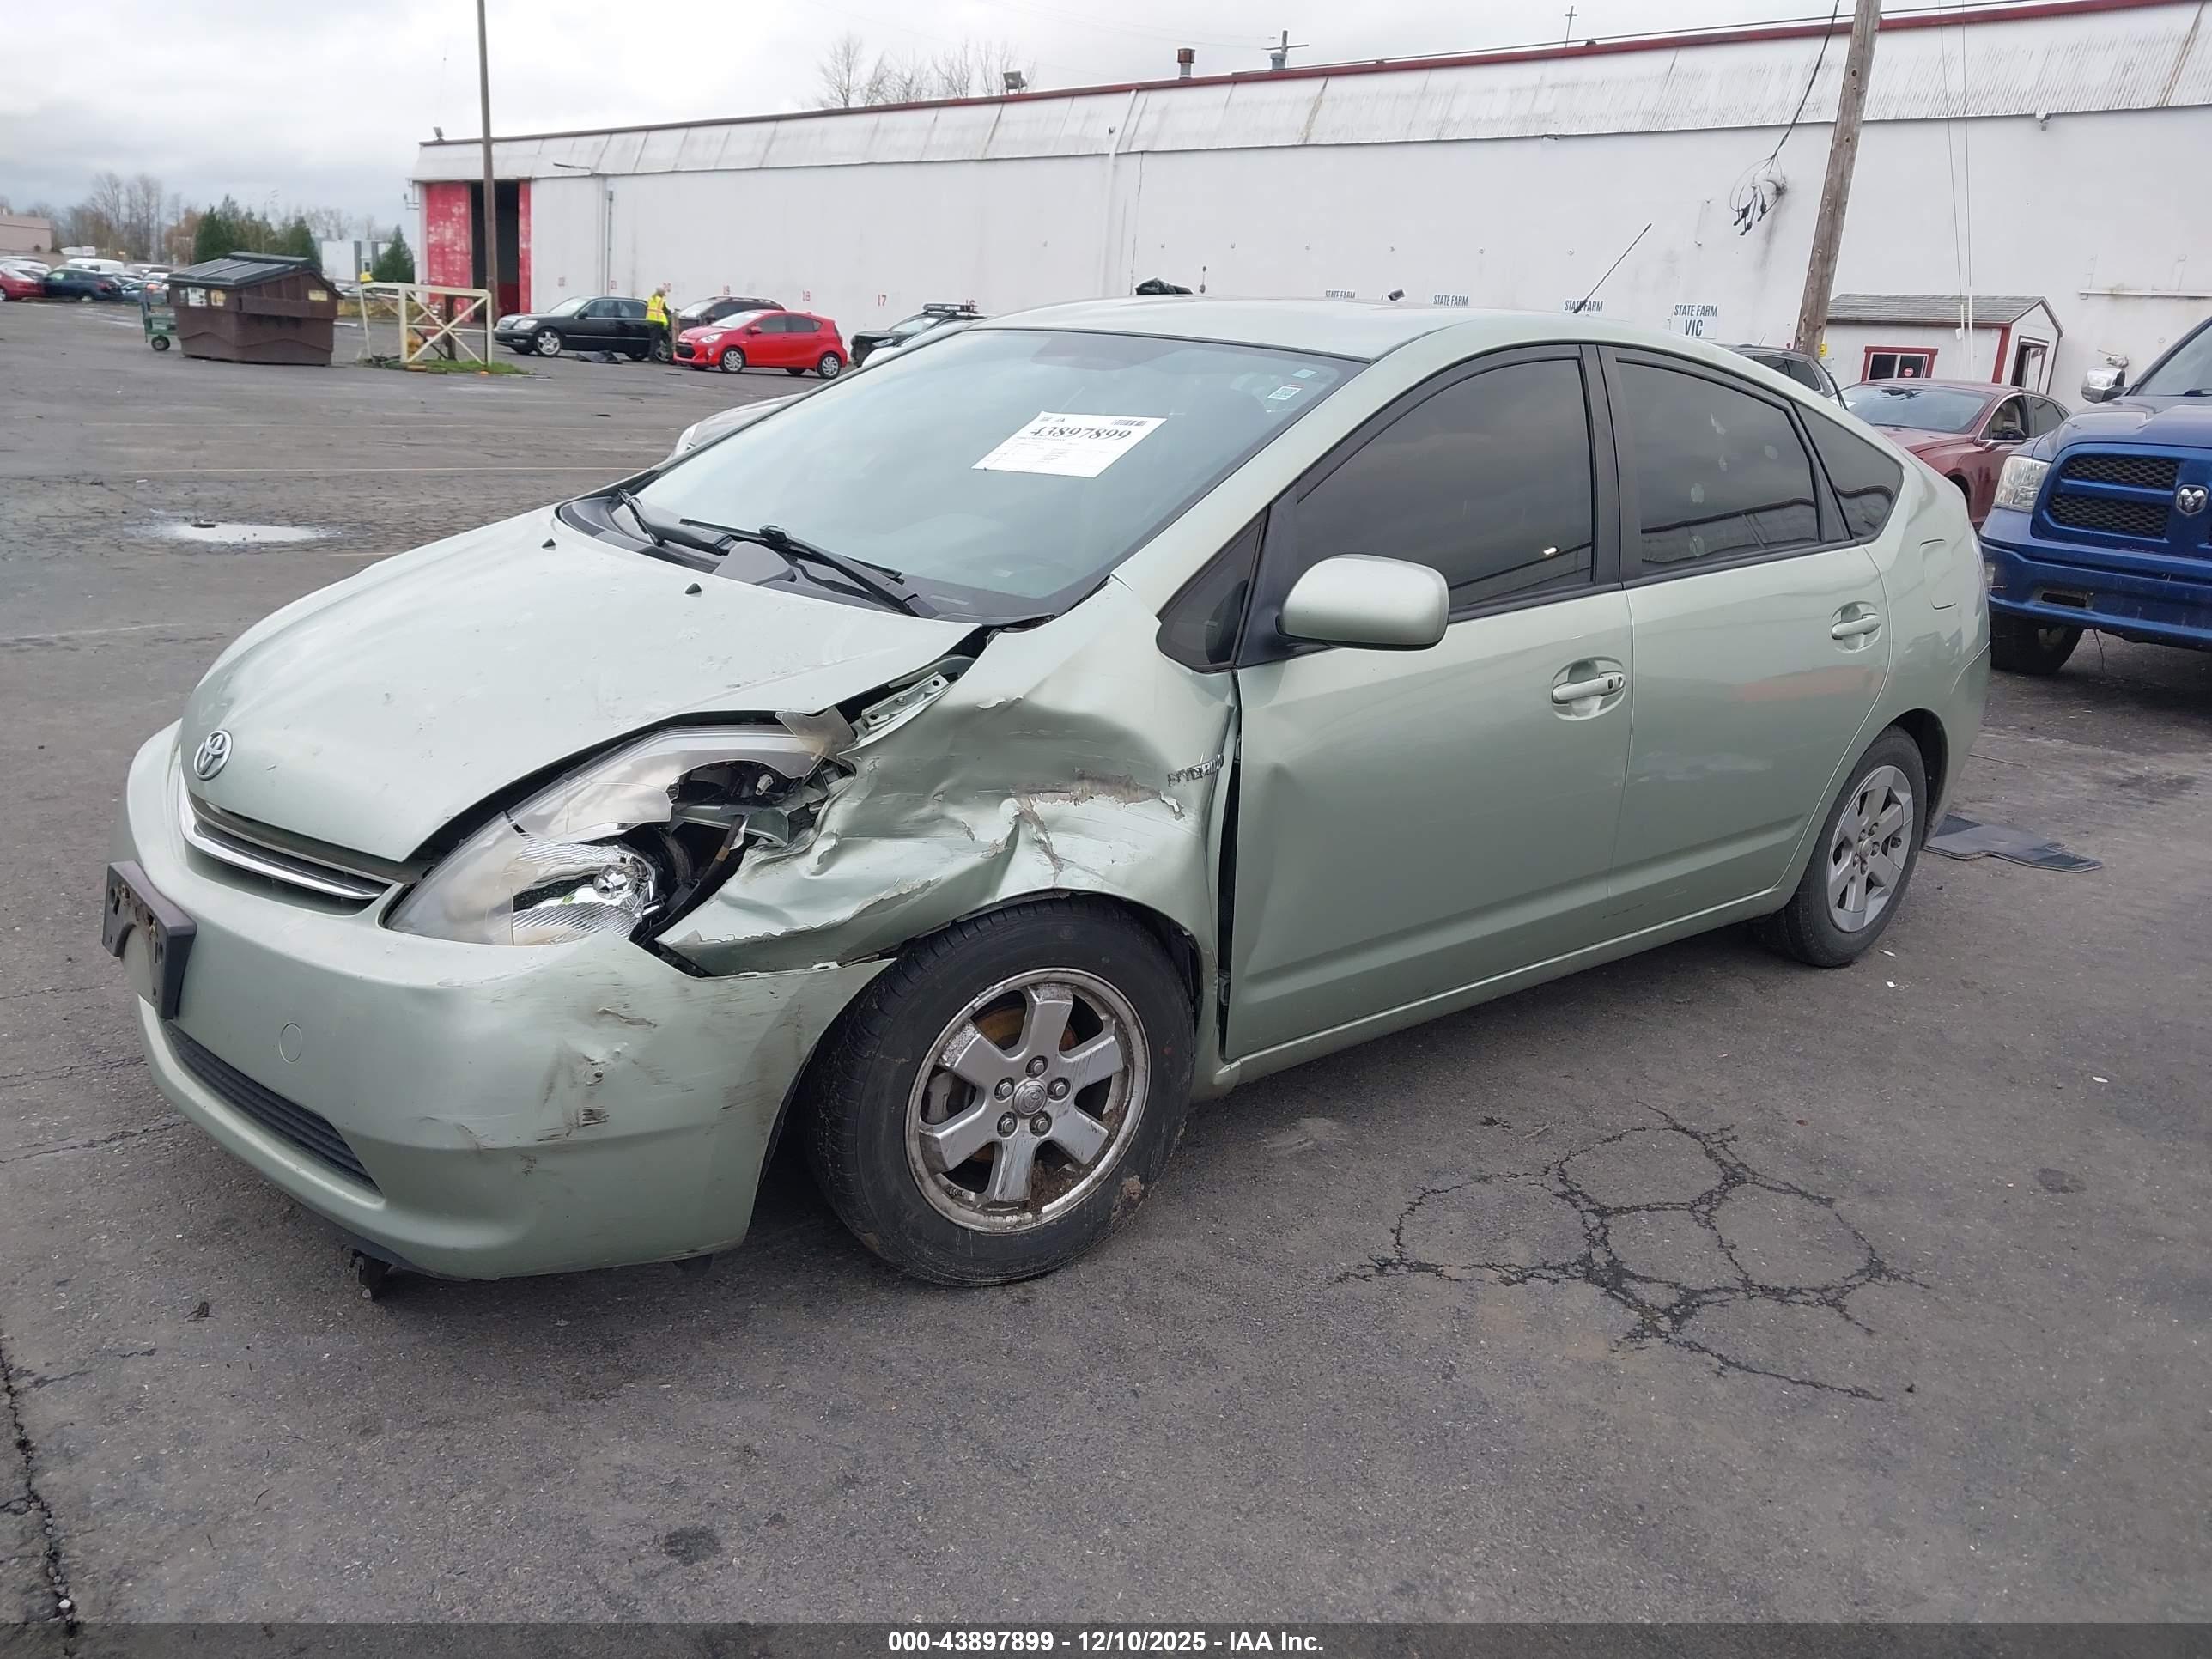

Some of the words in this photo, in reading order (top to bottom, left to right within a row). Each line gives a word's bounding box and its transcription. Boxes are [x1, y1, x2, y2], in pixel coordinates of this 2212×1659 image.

[1433, 295, 1450, 307] STATE
[1451, 295, 1468, 307] FARM
[1674, 304, 1695, 317] STATE
[1697, 305, 1717, 317] FARM
[1685, 319, 1703, 337] VIC
[1030, 426, 1132, 441] 43897899
